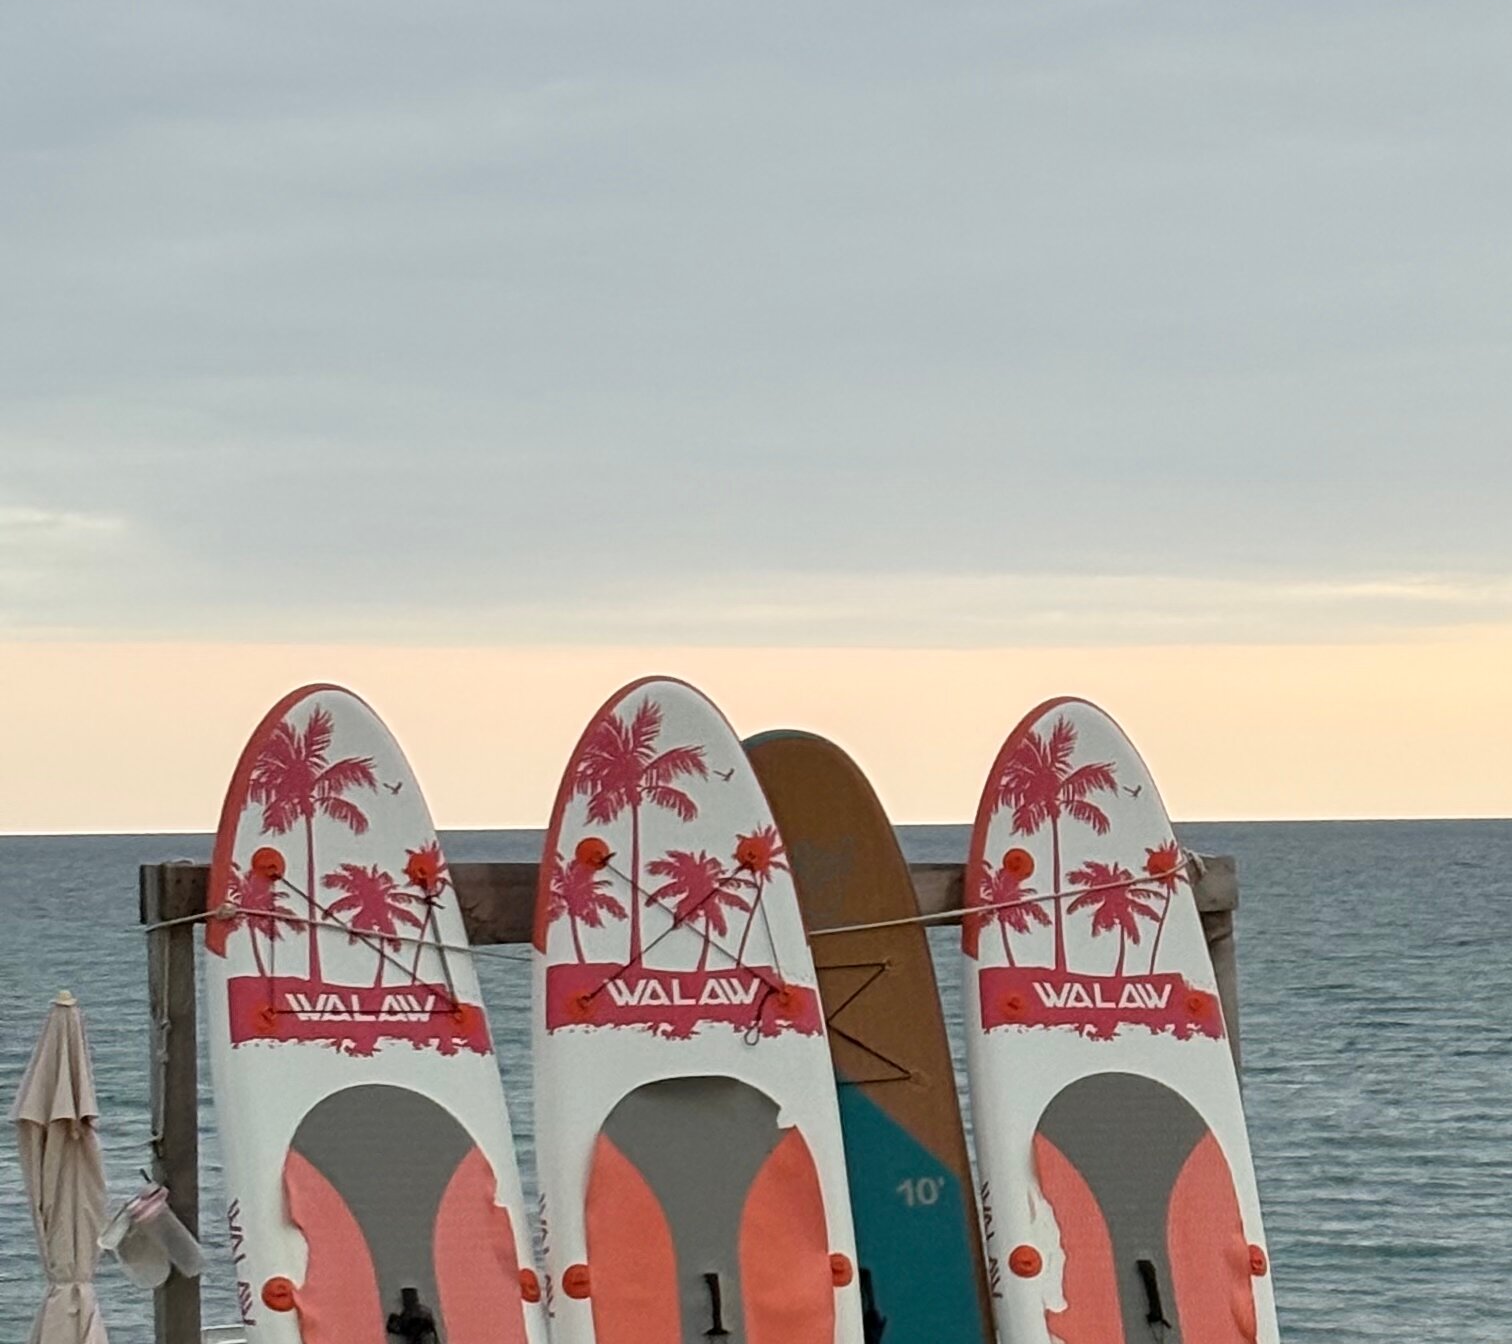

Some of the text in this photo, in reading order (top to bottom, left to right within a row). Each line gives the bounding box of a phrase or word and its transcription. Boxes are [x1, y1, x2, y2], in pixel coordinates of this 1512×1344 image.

[603, 978, 760, 1006] WALAW
[1032, 982, 1172, 1009] WALAW
[285, 993, 435, 1022] WALAW
